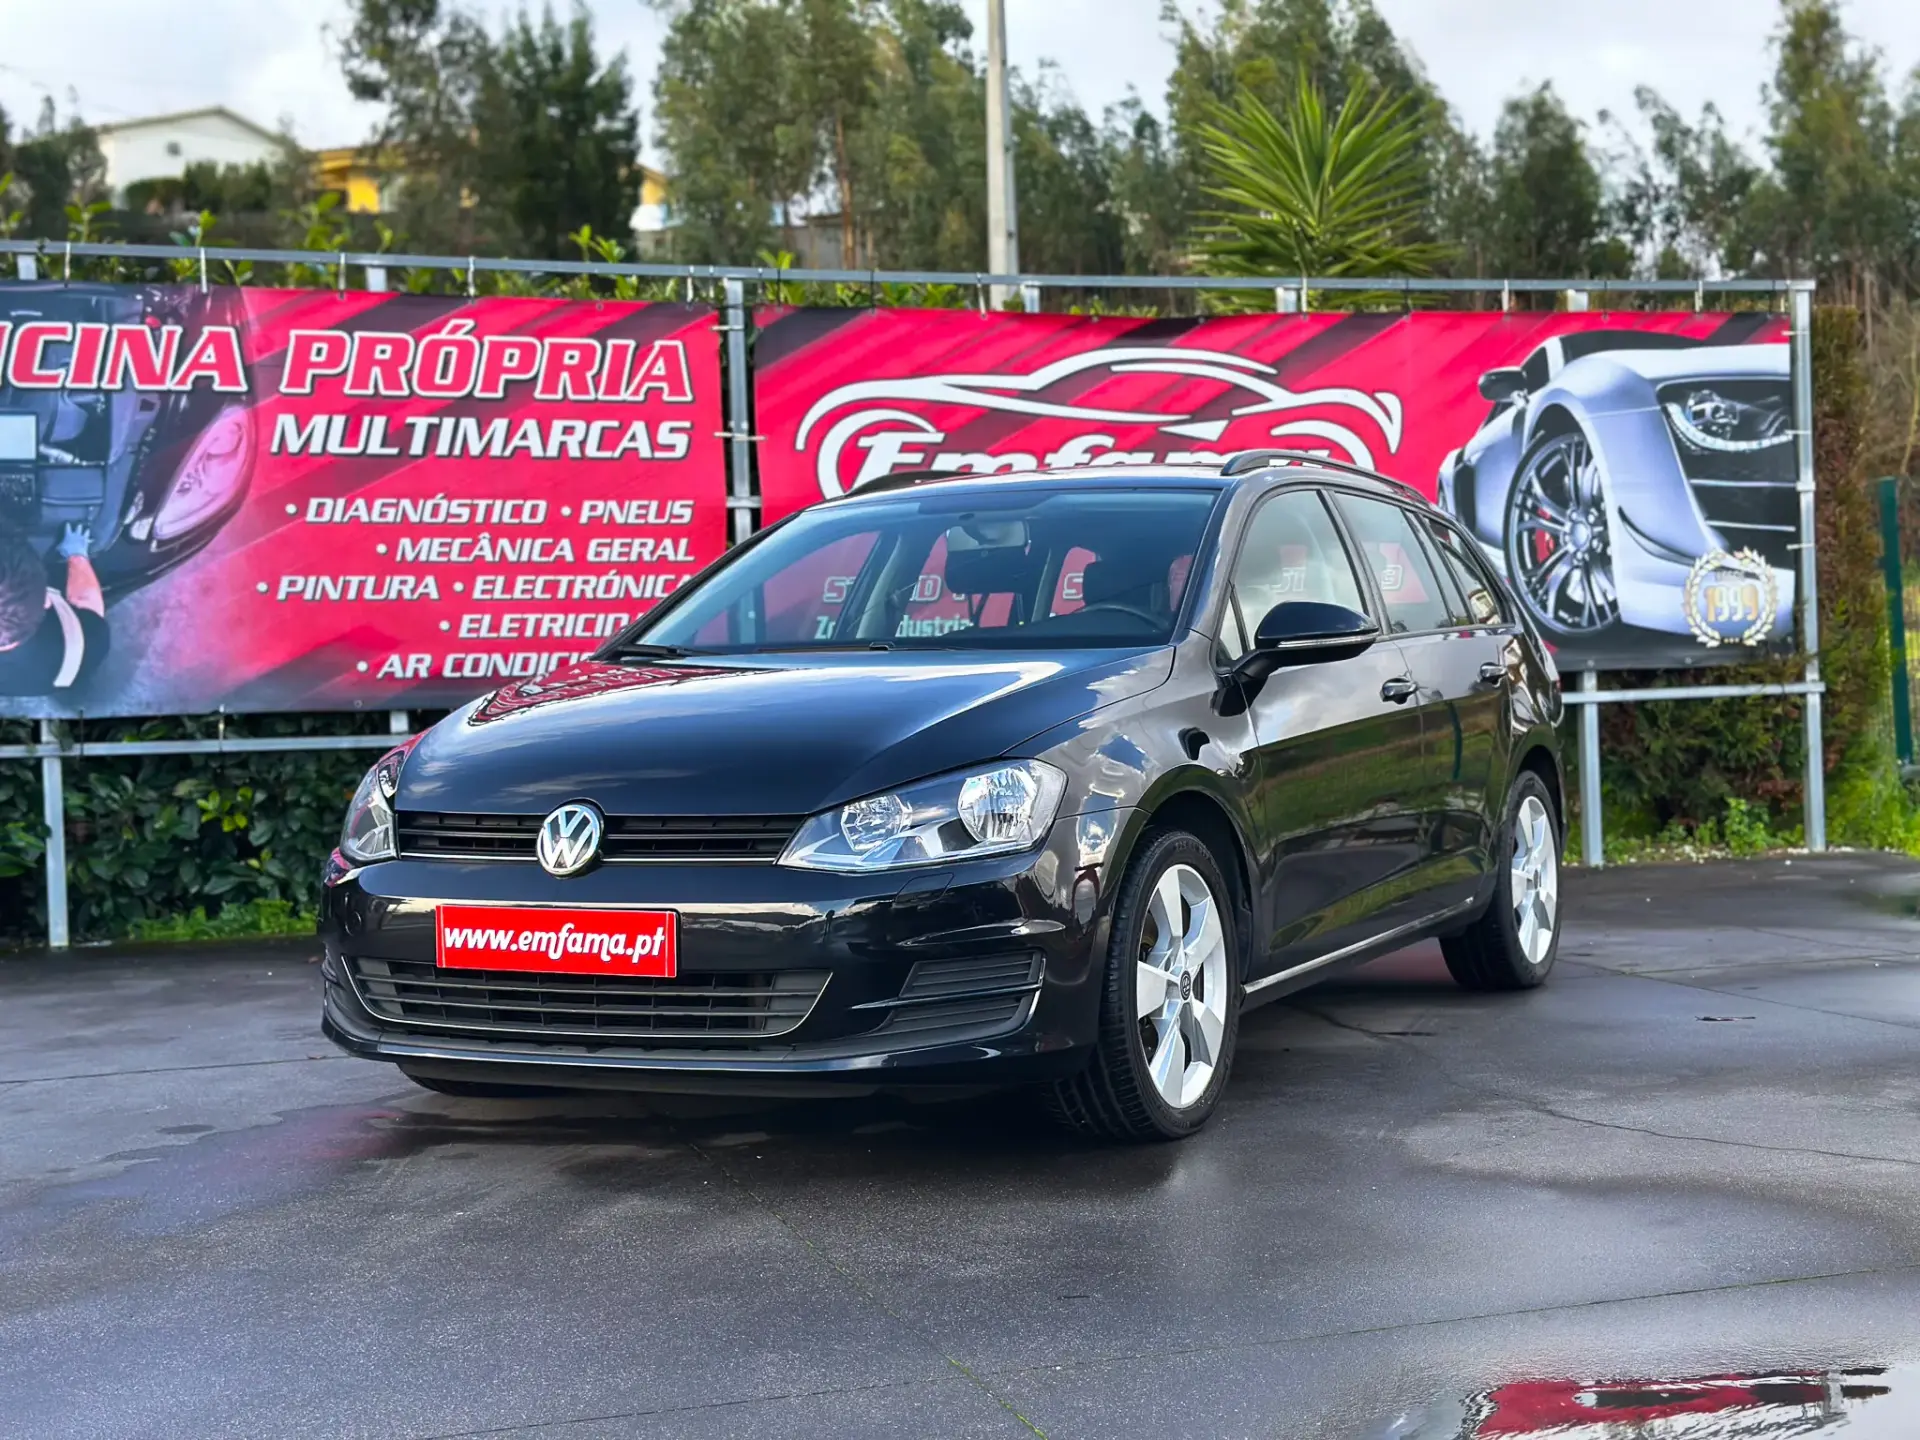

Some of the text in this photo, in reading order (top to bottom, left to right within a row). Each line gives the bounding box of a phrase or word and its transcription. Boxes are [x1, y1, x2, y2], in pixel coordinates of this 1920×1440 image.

[0, 319, 693, 402] CINA PRÓPRIA
[270, 414, 692, 459] MULTIMARCAS
[305, 494, 694, 525] DIAGNÓSTICO PNEUS
[396, 533, 695, 562] MECÂNICA GERAL
[277, 575, 440, 601] PINTURA
[1704, 585, 1758, 622] 1999
[459, 613, 645, 639] ELETRICID
[376, 651, 595, 678] AR CONDIC
[444, 923, 665, 964] www.emfama.pt
